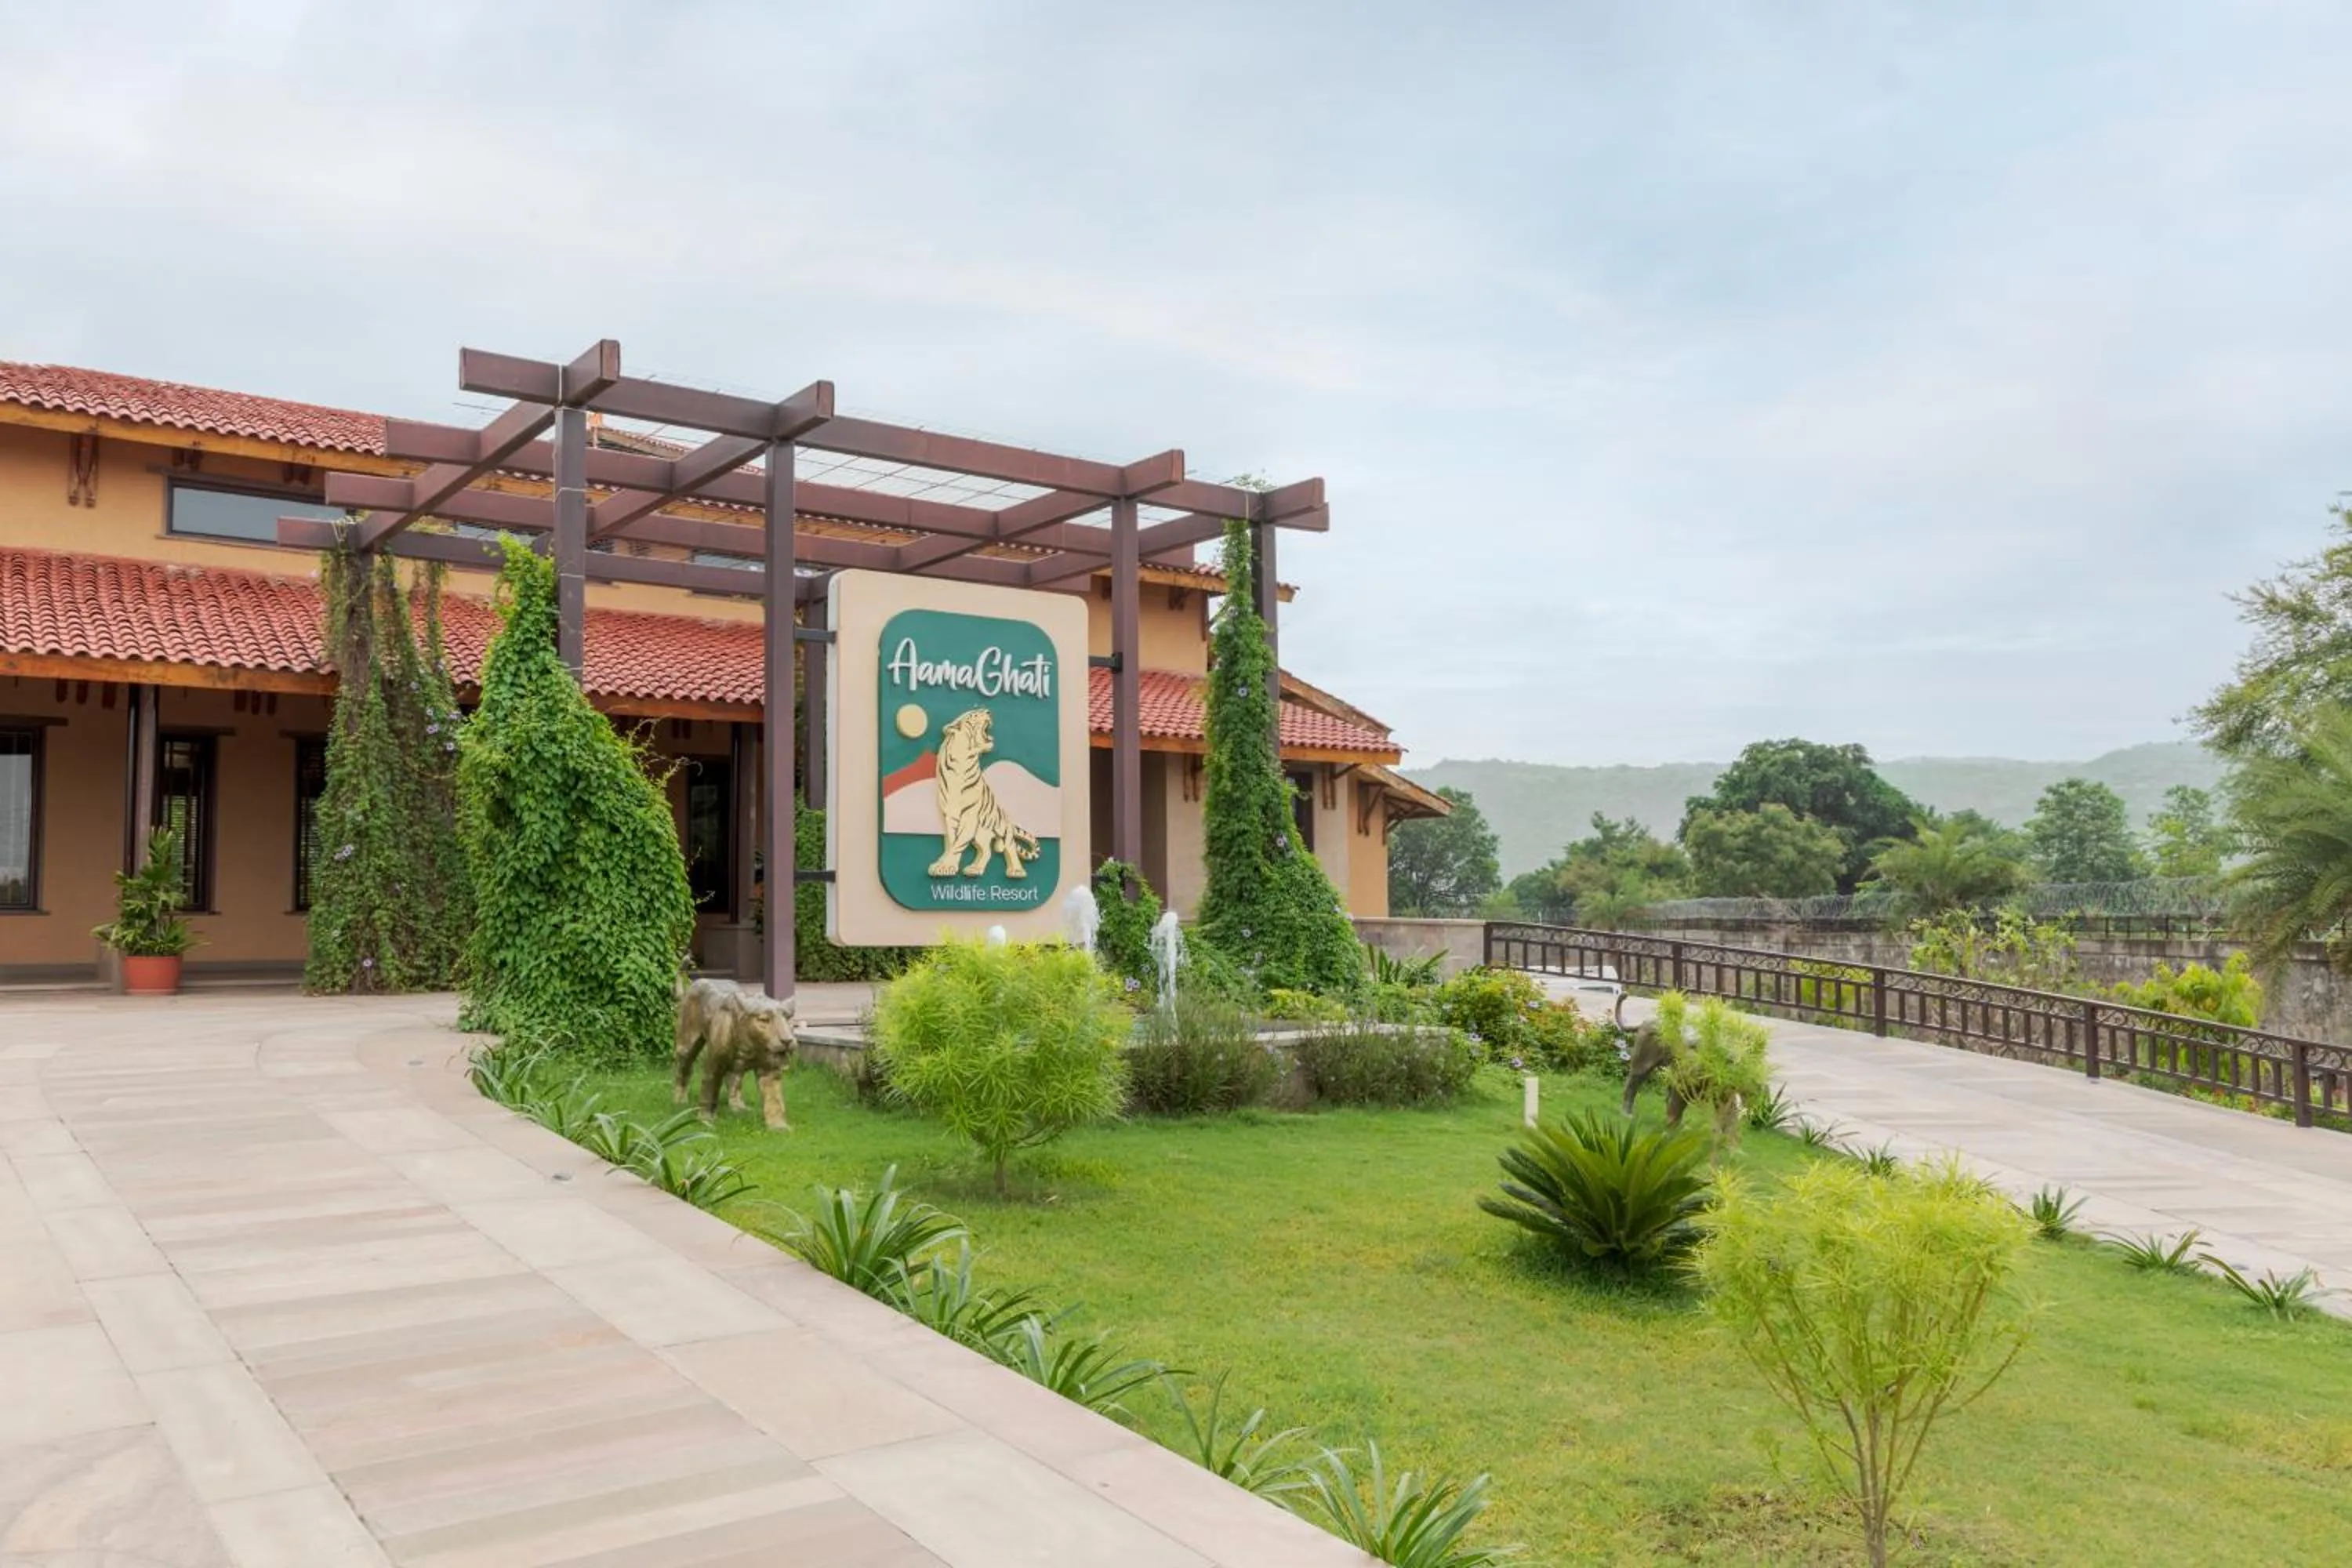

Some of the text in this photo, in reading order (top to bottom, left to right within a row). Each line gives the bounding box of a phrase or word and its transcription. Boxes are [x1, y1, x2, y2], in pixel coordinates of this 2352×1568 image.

[887, 637, 1052, 699] AamaGhati
[931, 884, 1038, 902] Wildlife Resort
